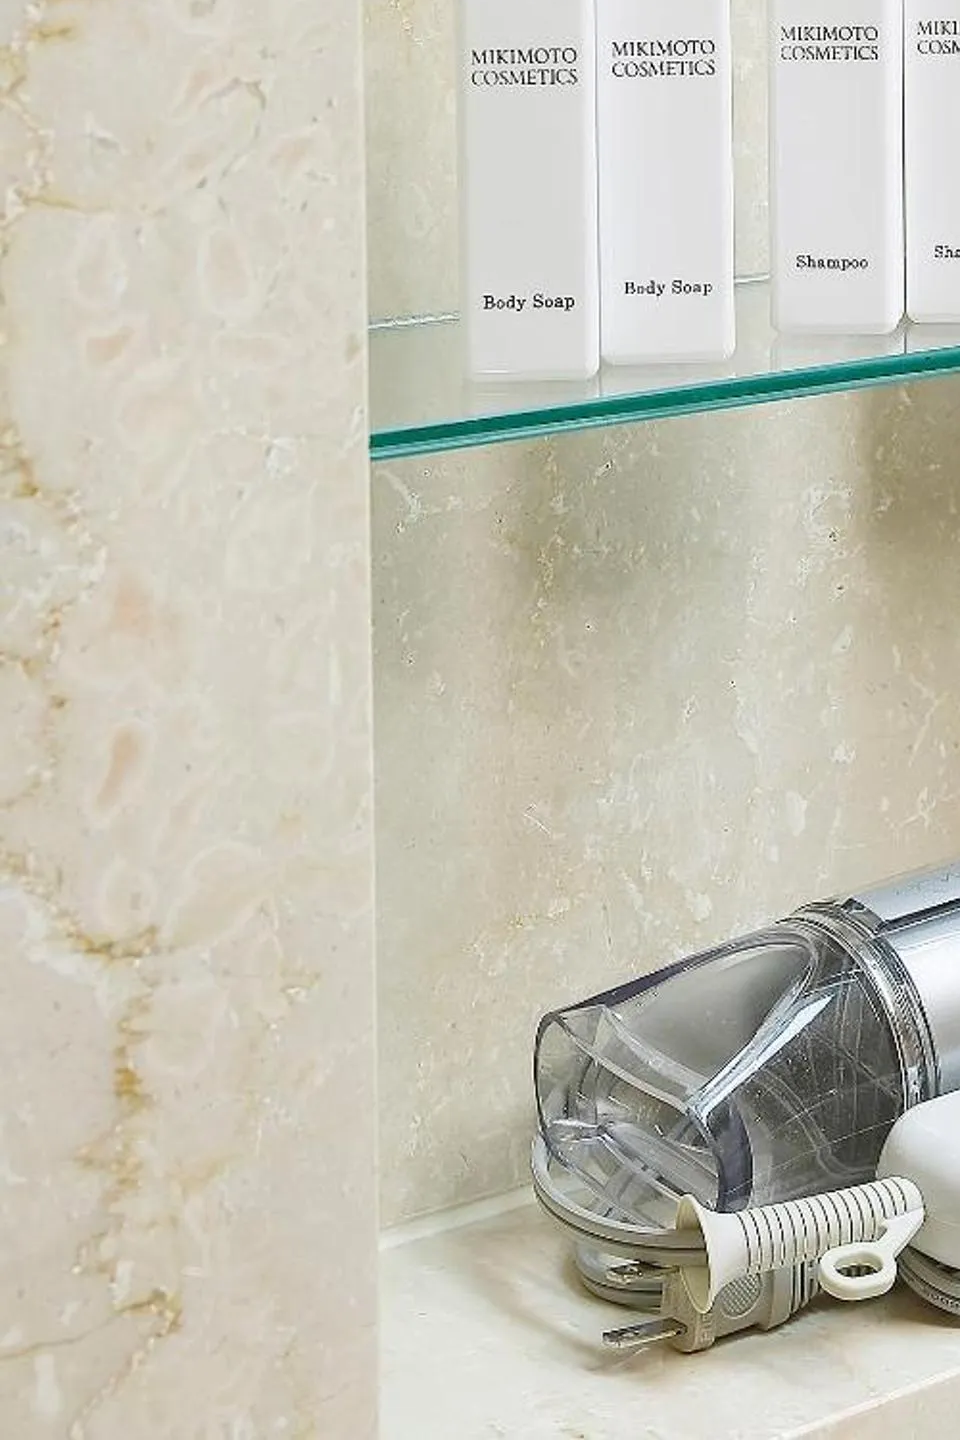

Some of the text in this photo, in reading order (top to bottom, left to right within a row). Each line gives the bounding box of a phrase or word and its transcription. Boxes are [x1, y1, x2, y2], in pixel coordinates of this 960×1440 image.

[781, 26, 878, 42] MIKIMOTO
[471, 47, 577, 65] MIKIMOTO
[611, 39, 715, 57] MIKIMOTO
[781, 45, 878, 61] COSMETICS
[471, 68, 578, 86] COSMETICS
[611, 59, 715, 78] COSMETICS
[795, 254, 868, 271] Shampoo
[624, 279, 713, 297] Body Soap
[483, 293, 575, 311] Body Soap
